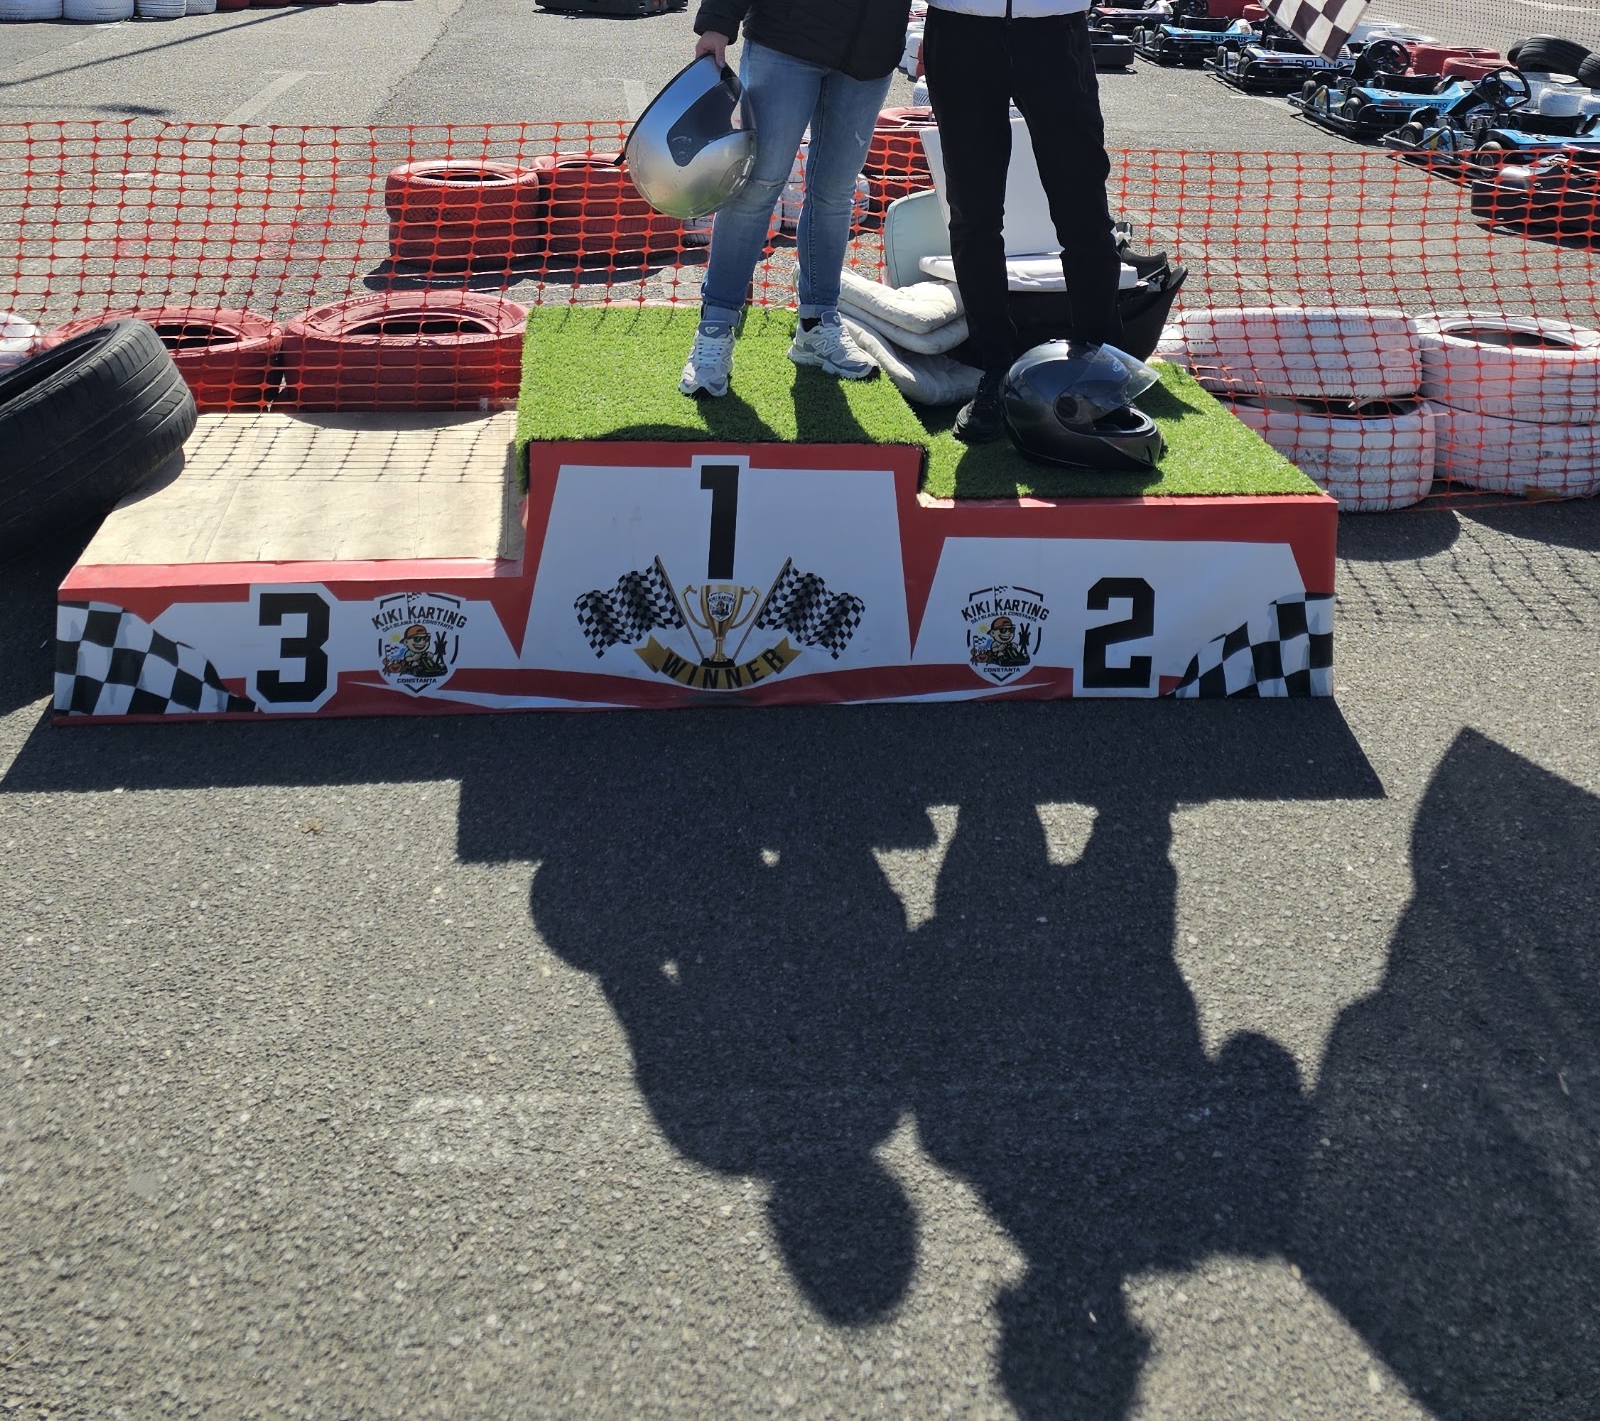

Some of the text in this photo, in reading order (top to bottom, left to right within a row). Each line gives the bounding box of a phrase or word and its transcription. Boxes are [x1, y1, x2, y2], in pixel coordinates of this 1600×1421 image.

[700, 465, 740, 580] 1
[256, 592, 330, 703] 3
[371, 606, 468, 630] KIKI KARTING
[961, 598, 1050, 622] KIKI KARTING
[1082, 577, 1155, 689] 2
[660, 648, 785, 690] WINNER
